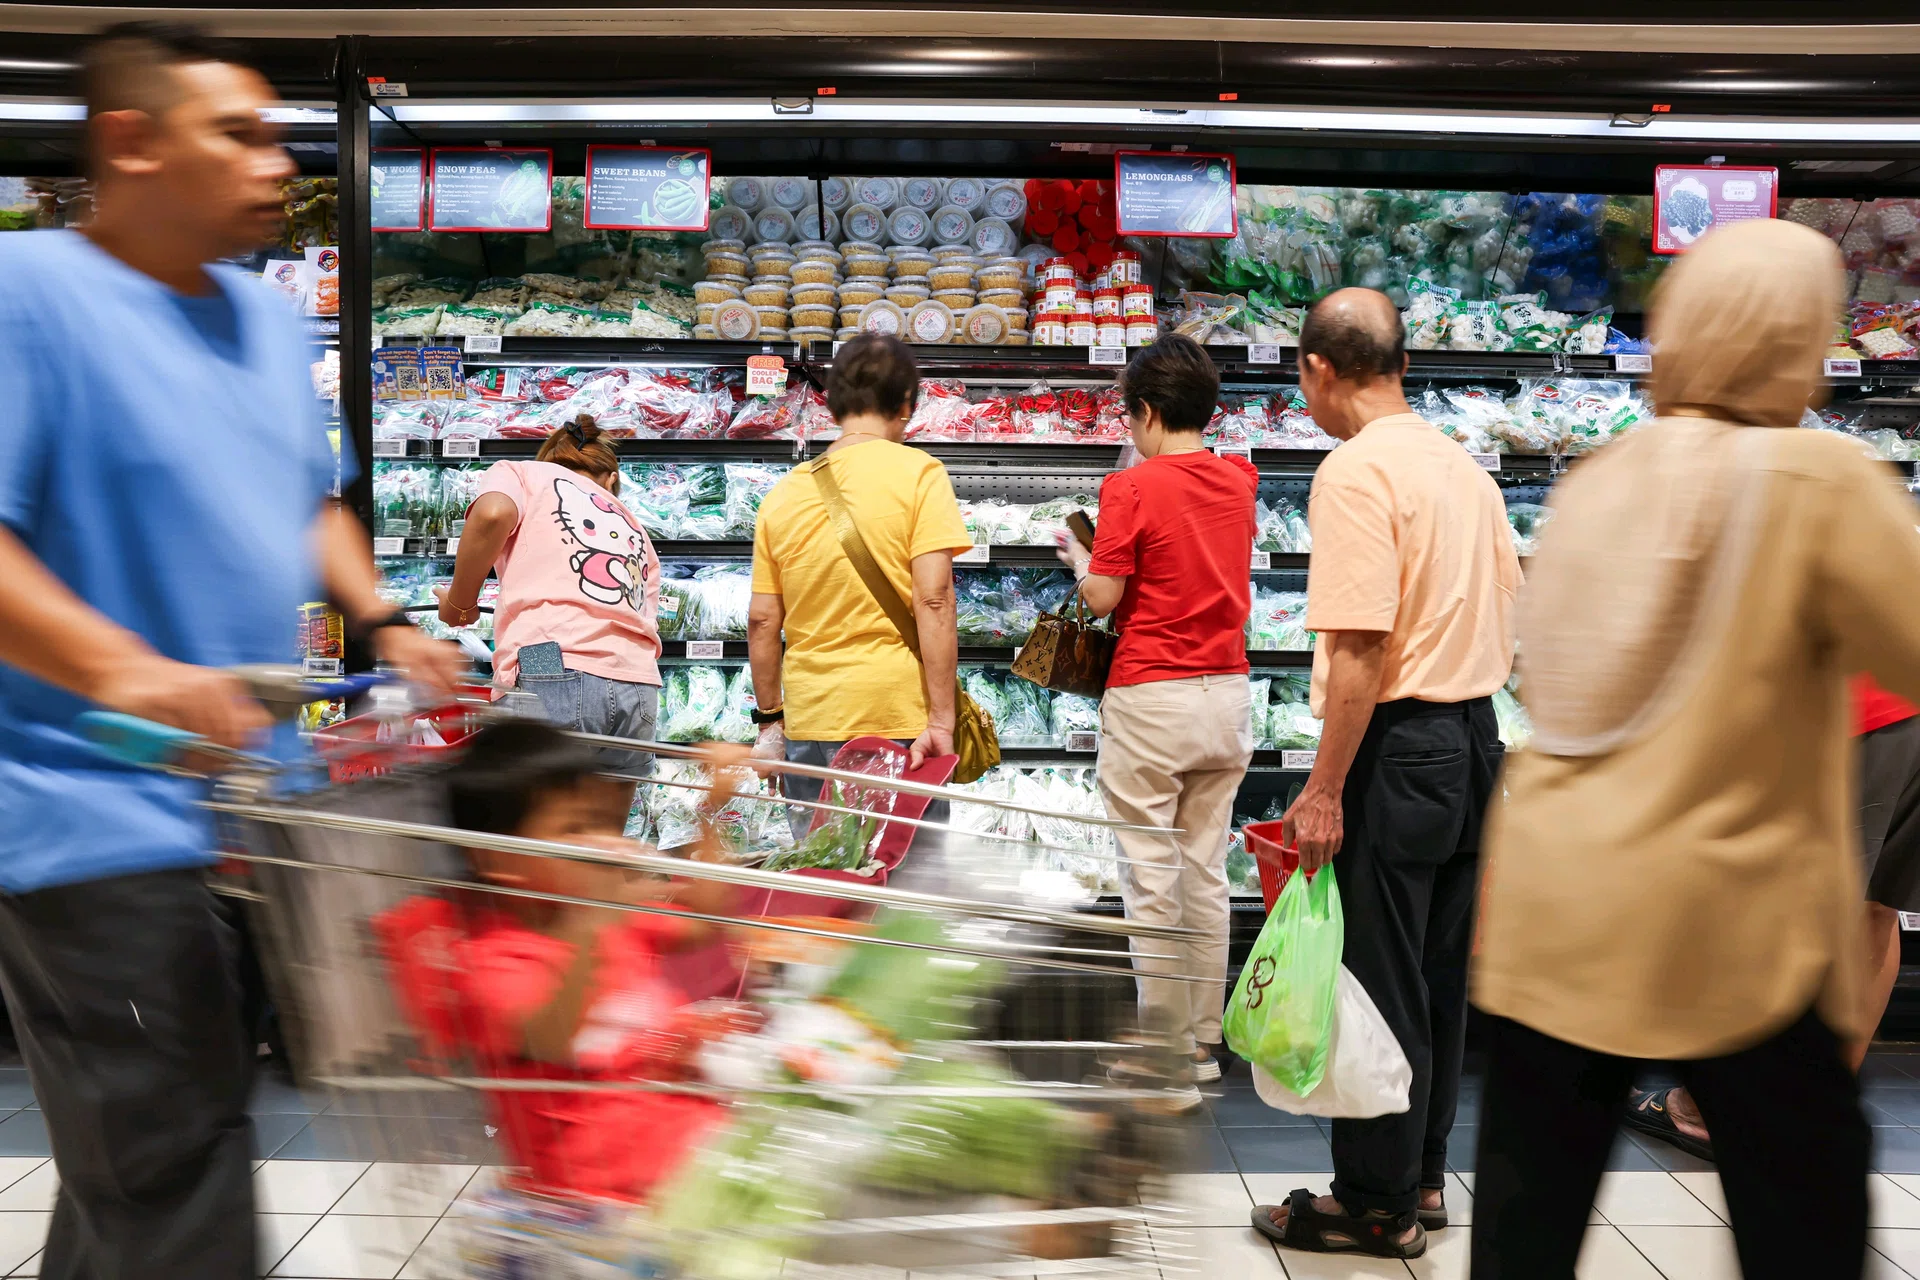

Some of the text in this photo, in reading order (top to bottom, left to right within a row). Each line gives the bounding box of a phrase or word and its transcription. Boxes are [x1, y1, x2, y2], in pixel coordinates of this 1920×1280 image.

[594, 167, 666, 177] SWEET BEANS
[1125, 173, 1193, 181] LEMONGRASS
[752, 359, 780, 367] FREE
